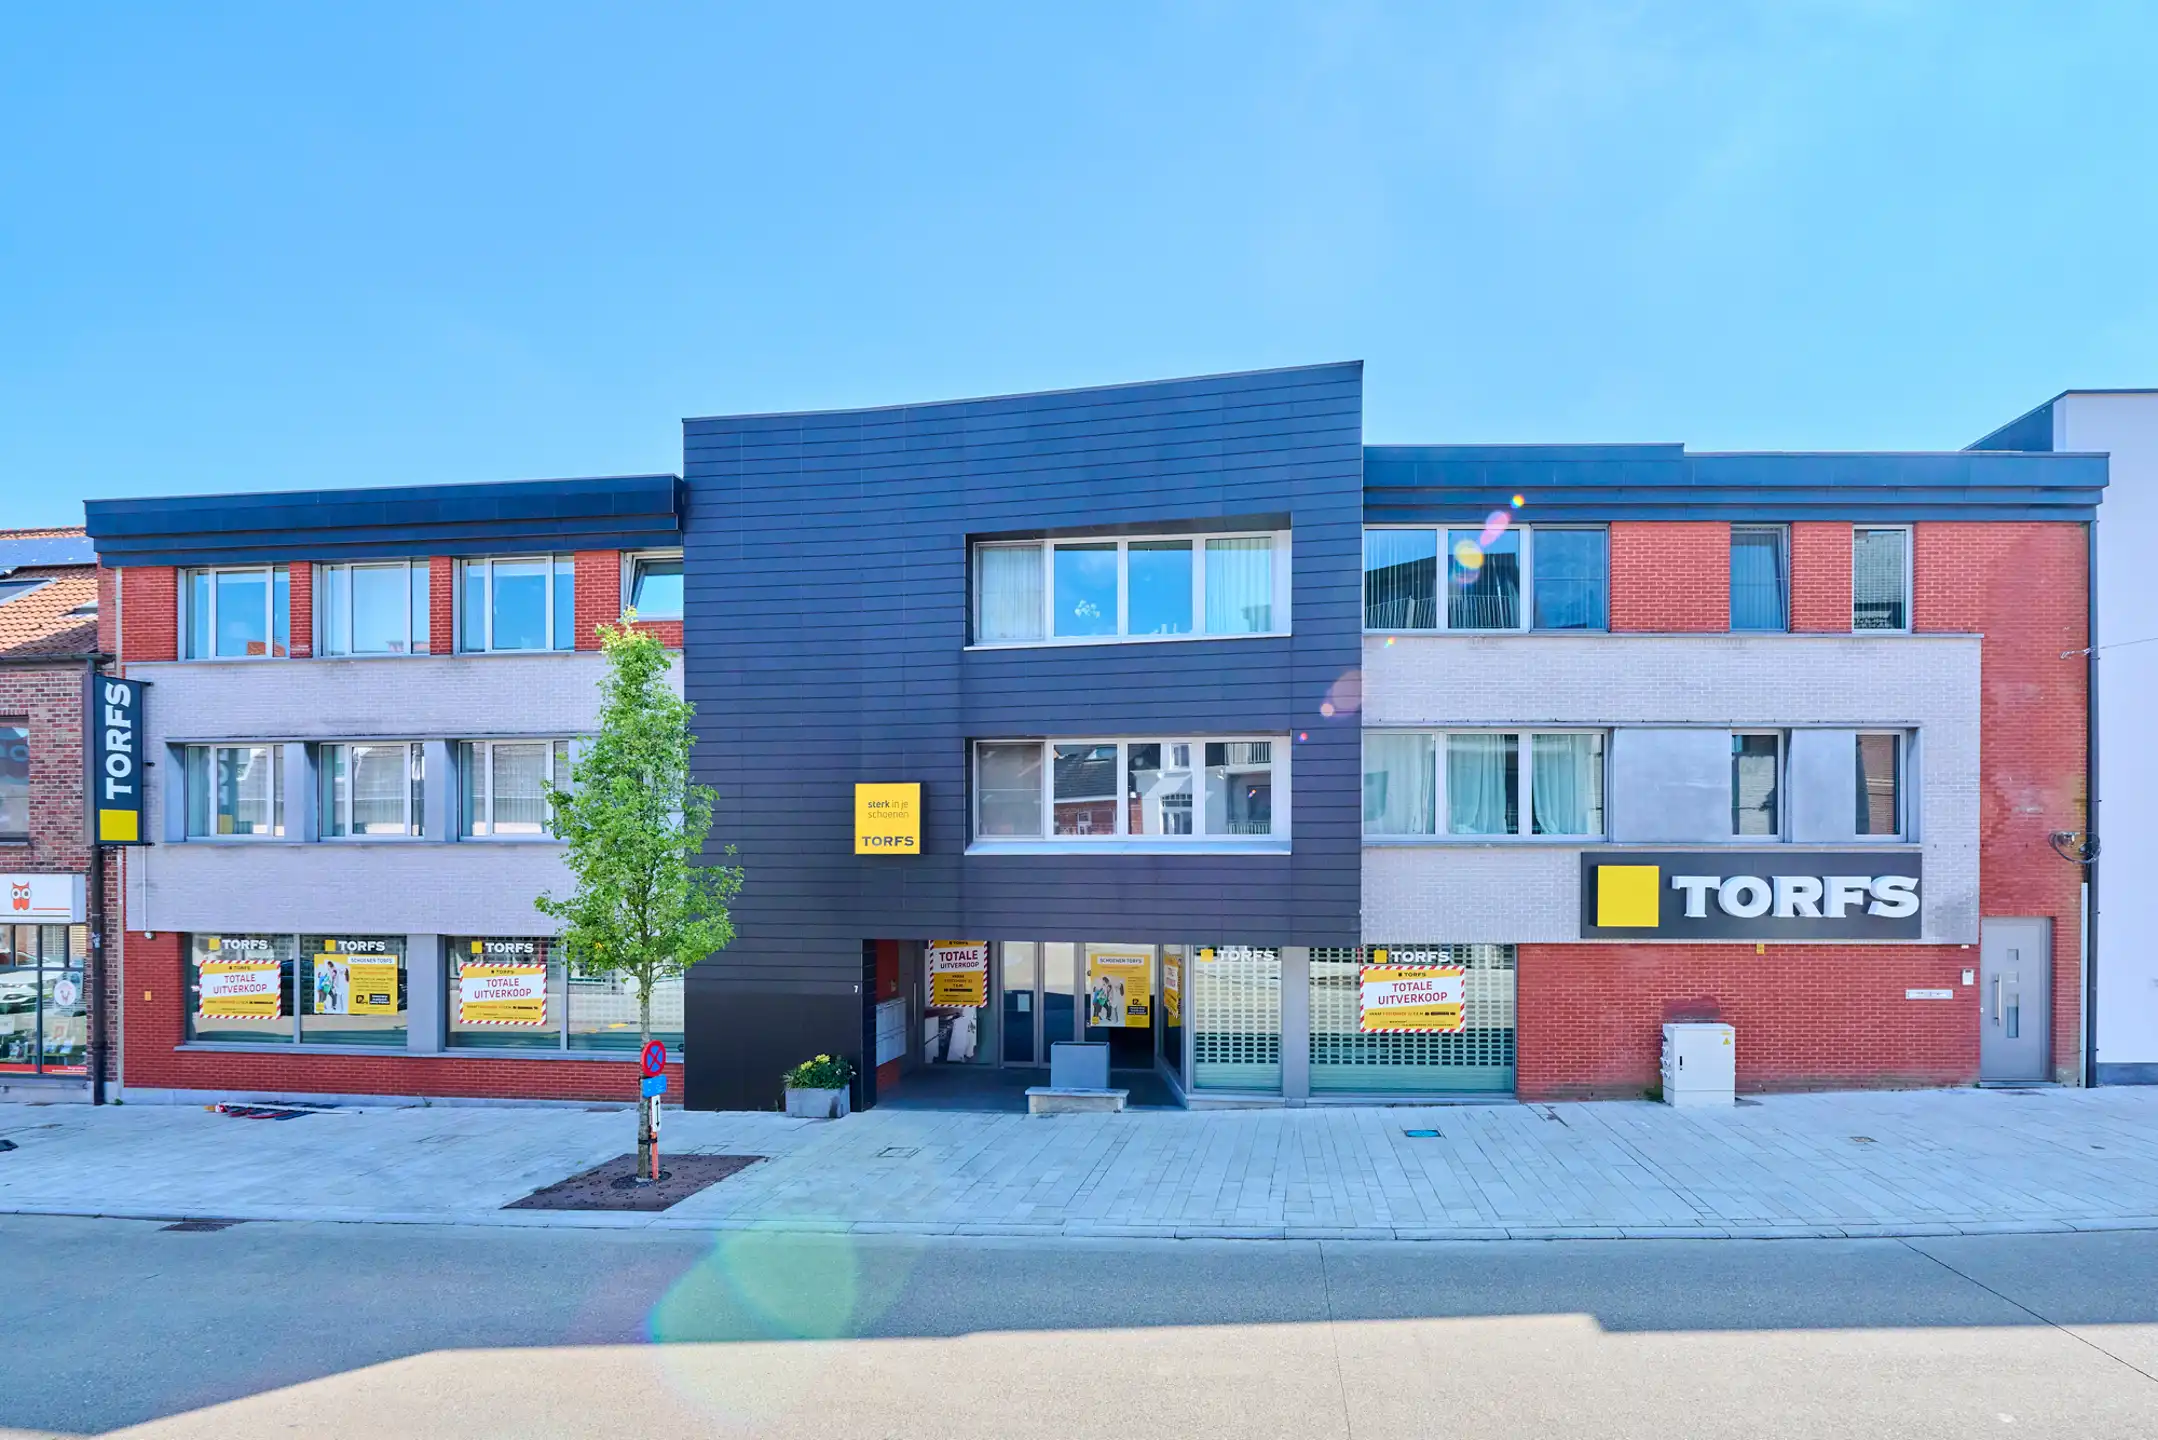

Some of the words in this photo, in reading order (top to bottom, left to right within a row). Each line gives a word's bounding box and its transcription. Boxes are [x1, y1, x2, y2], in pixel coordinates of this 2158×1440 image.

[105, 682, 132, 800] TORFS
[868, 800, 890, 808] sterk
[892, 800, 899, 808] in
[901, 800, 909, 810] je
[868, 810, 909, 818] schoenen
[862, 836, 914, 846] TORFS
[1671, 874, 1921, 919] TORFS
[221, 939, 268, 950] TORFS
[338, 940, 386, 952] TORFS
[485, 942, 534, 954] TORFS
[939, 950, 978, 962] TOTALE
[1217, 950, 1275, 962] TORFS
[1390, 951, 1450, 963] TORFS
[940, 961, 980, 969] UITVERKOOP
[224, 974, 256, 983] TOTALE
[486, 978, 519, 987] TOTALE
[213, 984, 267, 994] UITVERKOOP
[1392, 981, 1433, 992] TOTALE
[474, 988, 531, 998] UITVERKOOP
[1378, 992, 1448, 1005] UITVERKOOP
